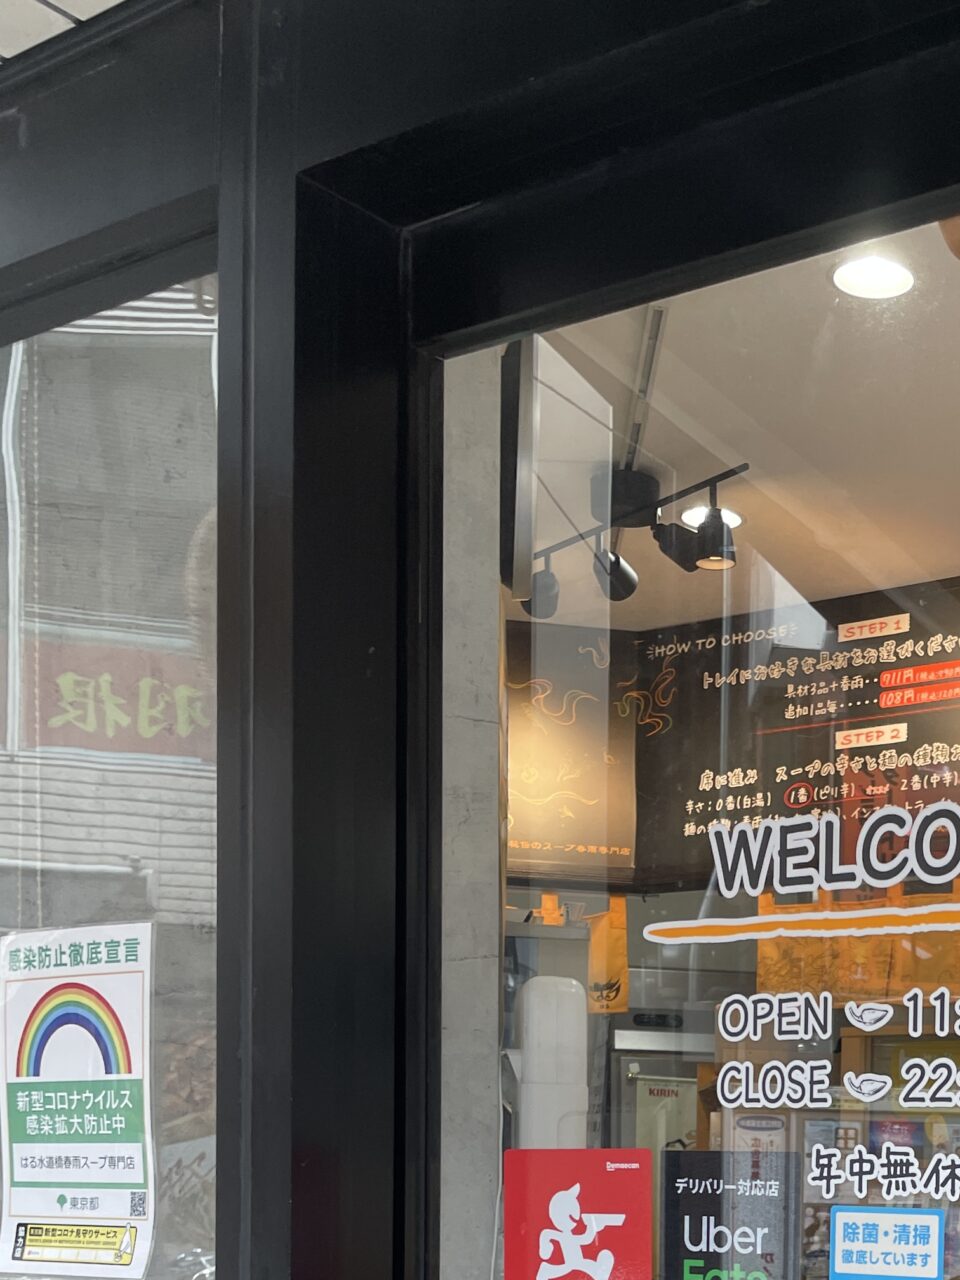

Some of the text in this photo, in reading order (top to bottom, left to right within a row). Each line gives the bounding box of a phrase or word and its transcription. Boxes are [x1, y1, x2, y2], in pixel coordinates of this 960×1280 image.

[843, 618, 903, 639] STEP 1
[654, 625, 788, 657] HOW TO CHOOSE
[841, 729, 901, 748] STEP 2
[8, 938, 140, 970] 感染防止徹底宣言
[720, 994, 830, 1038] OPEN
[648, 1087, 679, 1097] KIRIN
[719, 1062, 830, 1104] CLOSE
[16, 1090, 132, 1111] 新型コロナウイルス
[25, 1114, 126, 1136] 感染拡大防止中
[675, 1178, 780, 1197] デリバリー対応店
[69, 1196, 99, 1211] 東京都
[683, 1215, 768, 1254] Uber
[842, 1223, 931, 1246] 除菌・清掃
[841, 1250, 932, 1267] 徹底しています
